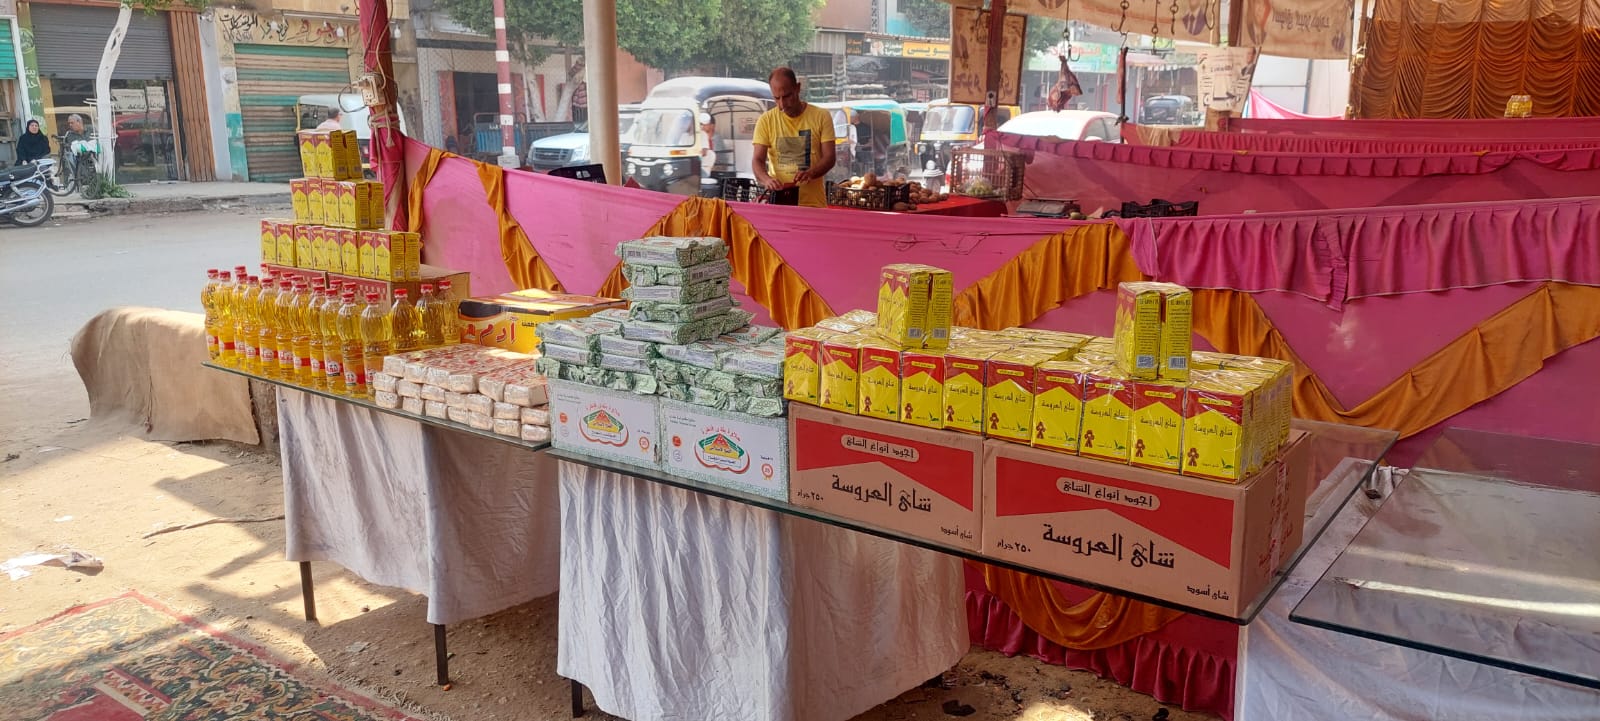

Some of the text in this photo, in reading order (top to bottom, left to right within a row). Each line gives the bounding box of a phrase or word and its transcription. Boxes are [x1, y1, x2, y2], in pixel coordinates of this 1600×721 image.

[480, 315, 519, 346] آدم
[797, 488, 810, 499] جرام
[832, 474, 892, 507] العروسة
[996, 538, 1031, 553] ٢٥٠ جرام
[1043, 523, 1123, 562] العروسة
[1186, 584, 1210, 597] أسود
